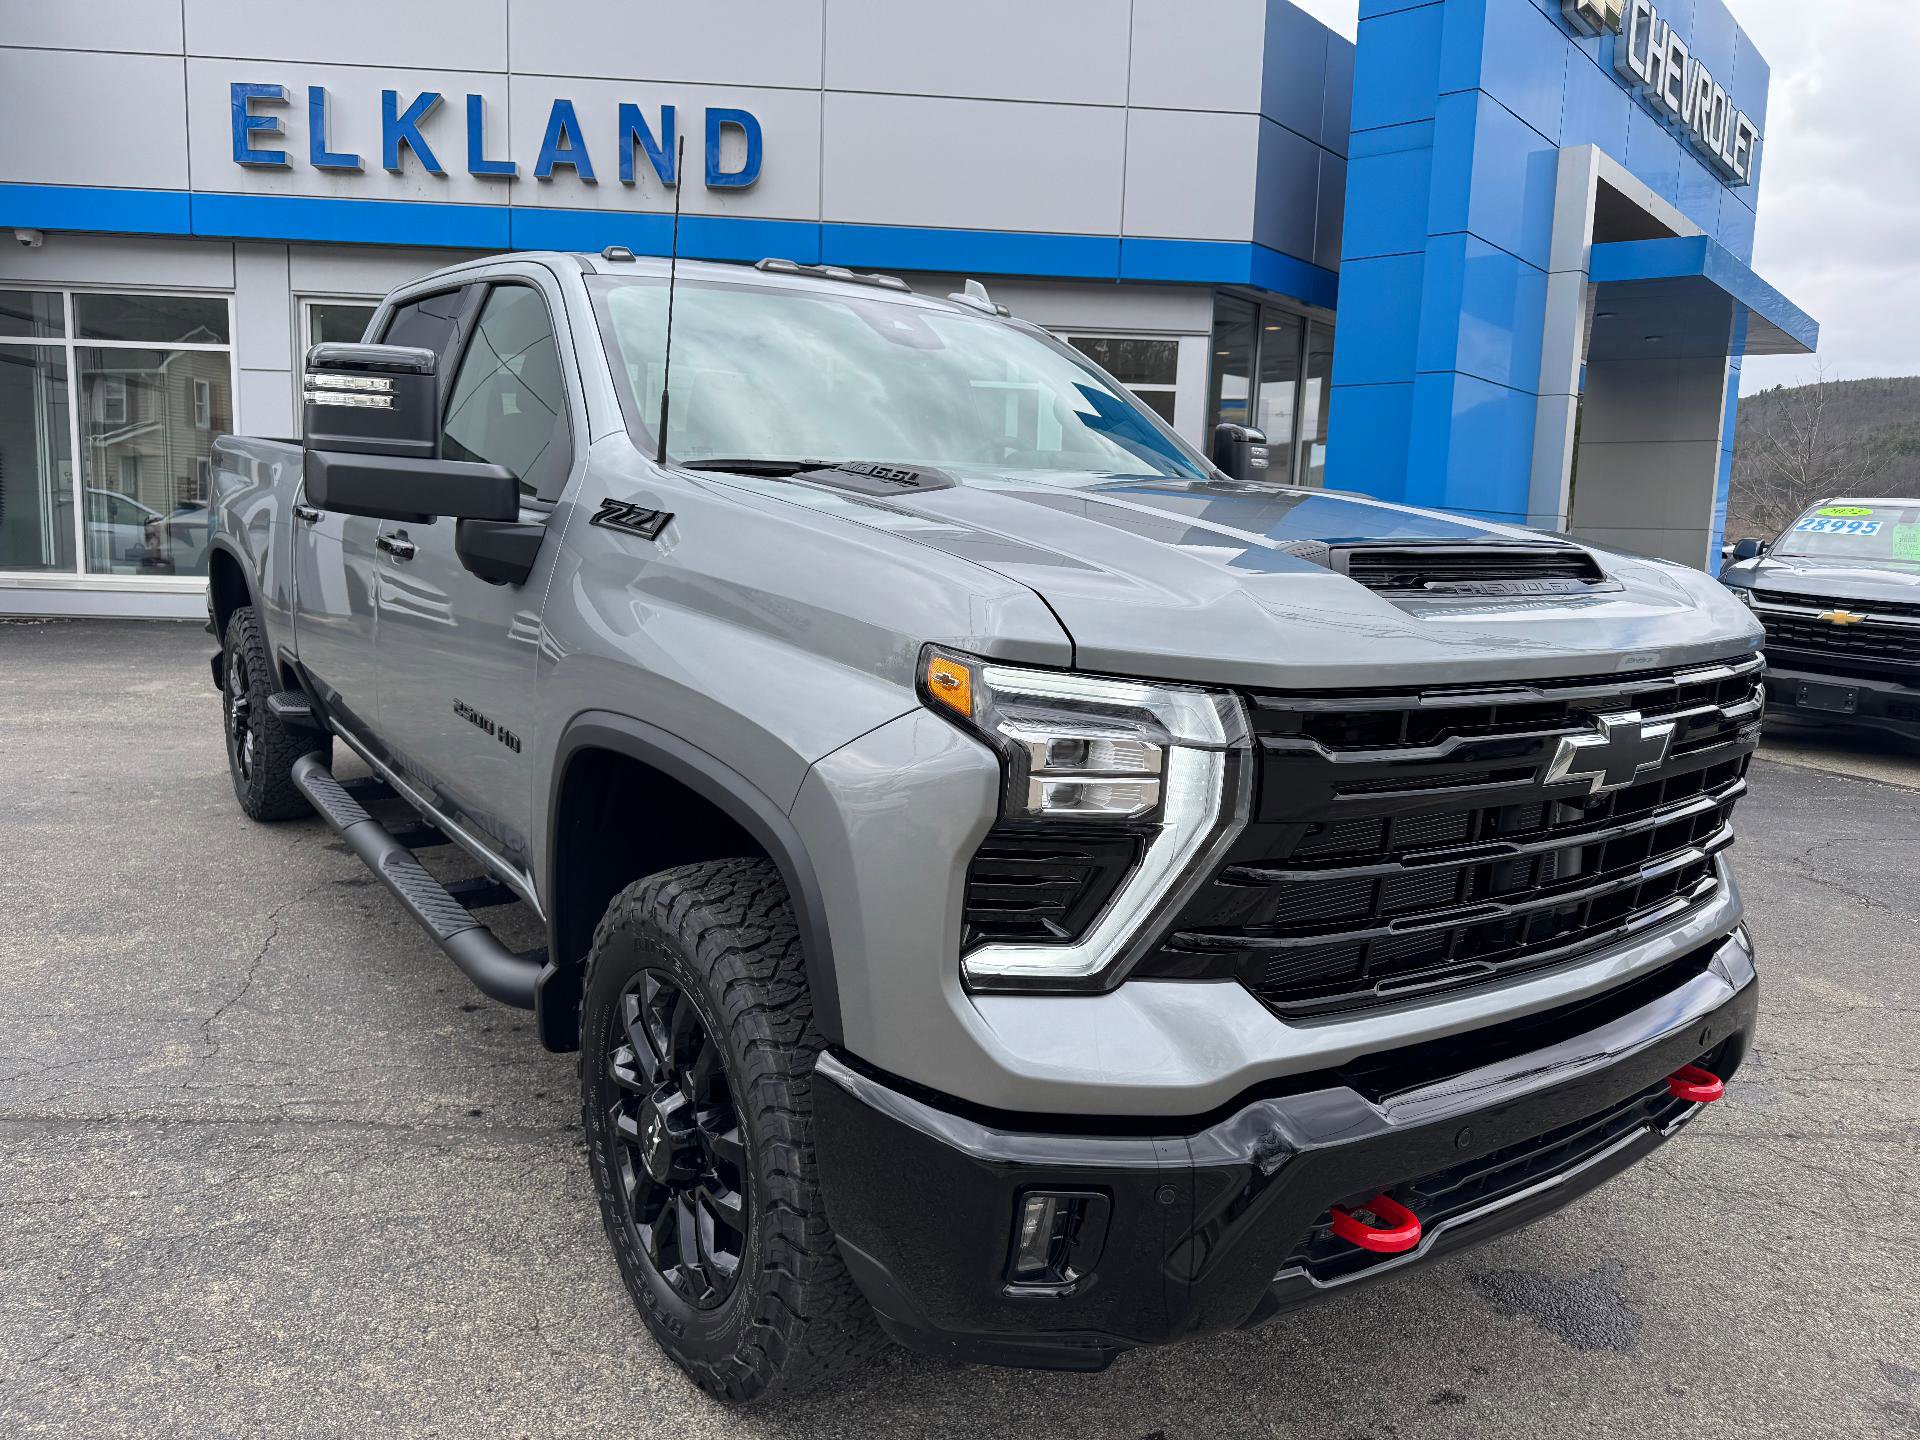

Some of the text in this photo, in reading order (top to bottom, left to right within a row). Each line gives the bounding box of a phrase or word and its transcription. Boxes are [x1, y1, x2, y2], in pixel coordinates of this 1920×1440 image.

[1622, 0, 1759, 187] CHEVROLET
[230, 82, 764, 191] ELKLAND
[589, 497, 675, 541] Z71
[1795, 518, 1881, 535] 28995
[1454, 581, 1570, 595] CHEVROLET
[453, 697, 521, 753] 2500 HD
